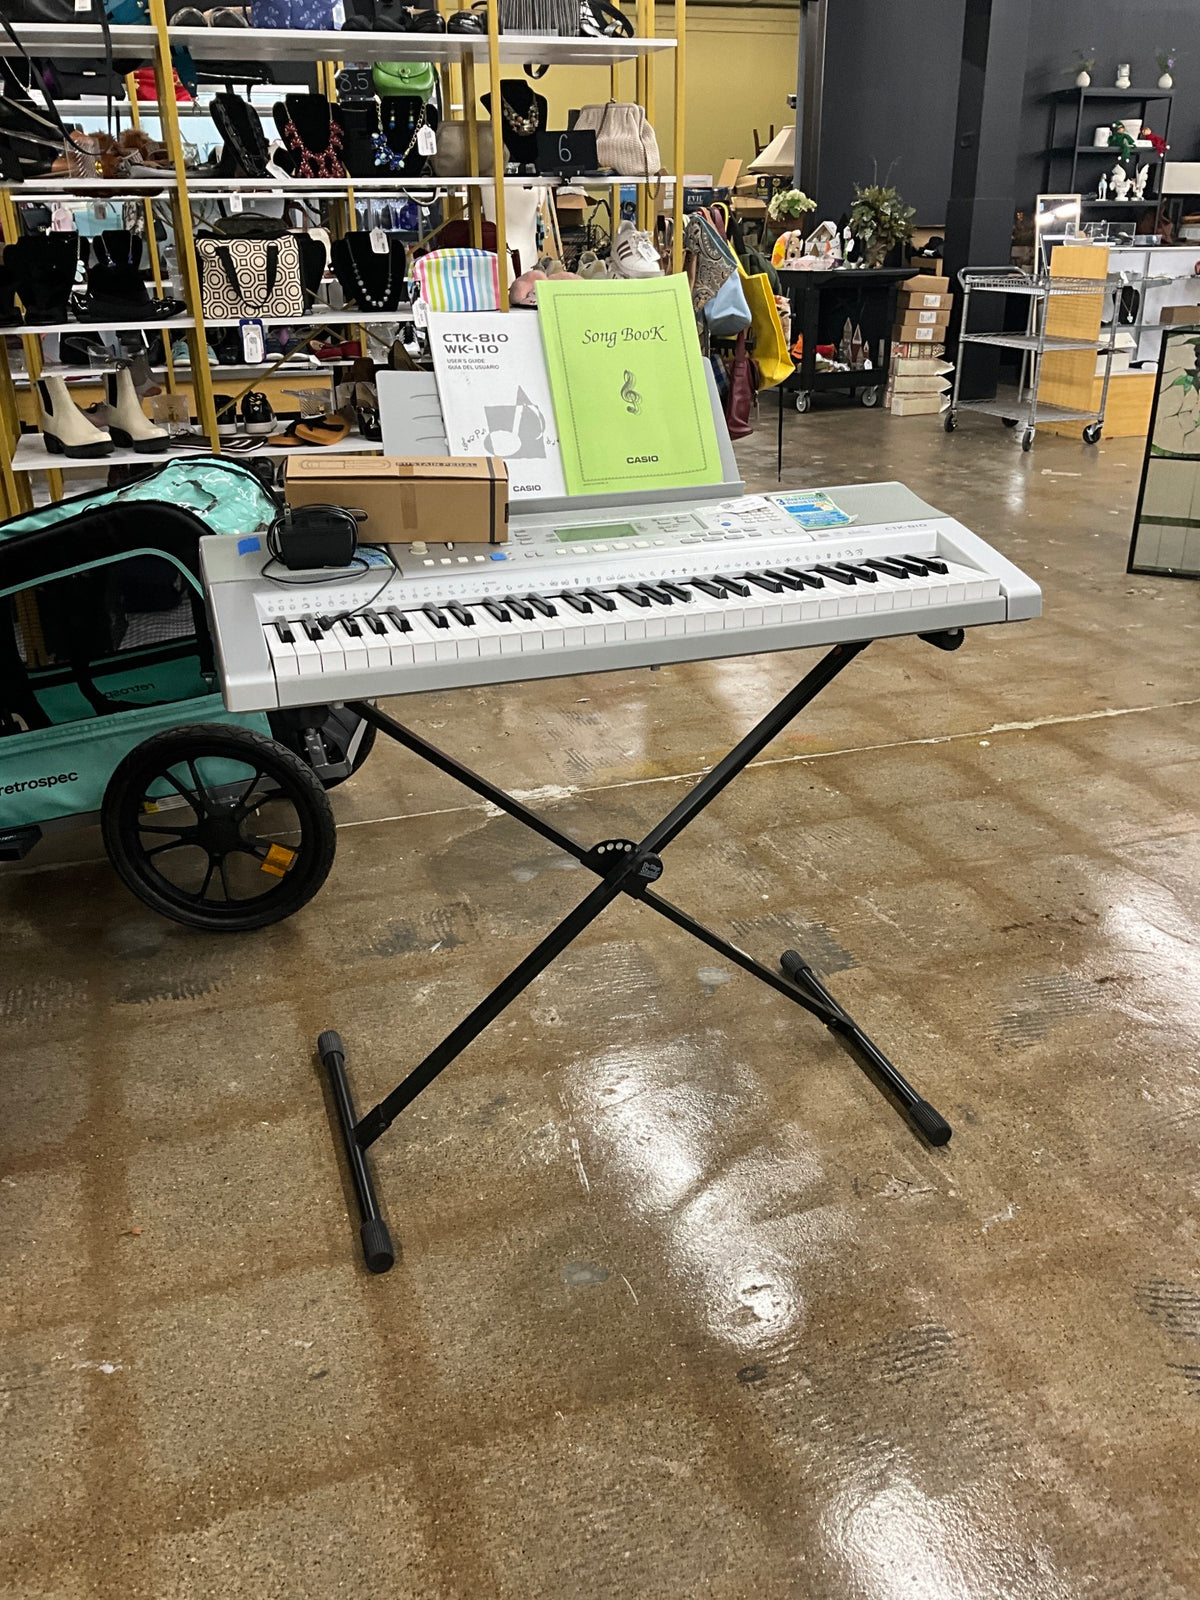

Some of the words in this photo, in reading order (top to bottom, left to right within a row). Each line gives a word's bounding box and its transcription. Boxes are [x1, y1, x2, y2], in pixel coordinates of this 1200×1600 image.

[340, 72, 369, 92] 8.5
[558, 133, 572, 162] 6
[442, 333, 509, 343] CTK-810
[582, 329, 617, 348] Song
[444, 344, 499, 354] WK-110
[626, 455, 659, 464] CASIO
[512, 484, 542, 492] CASIO
[0, 772, 78, 796] retrospec
